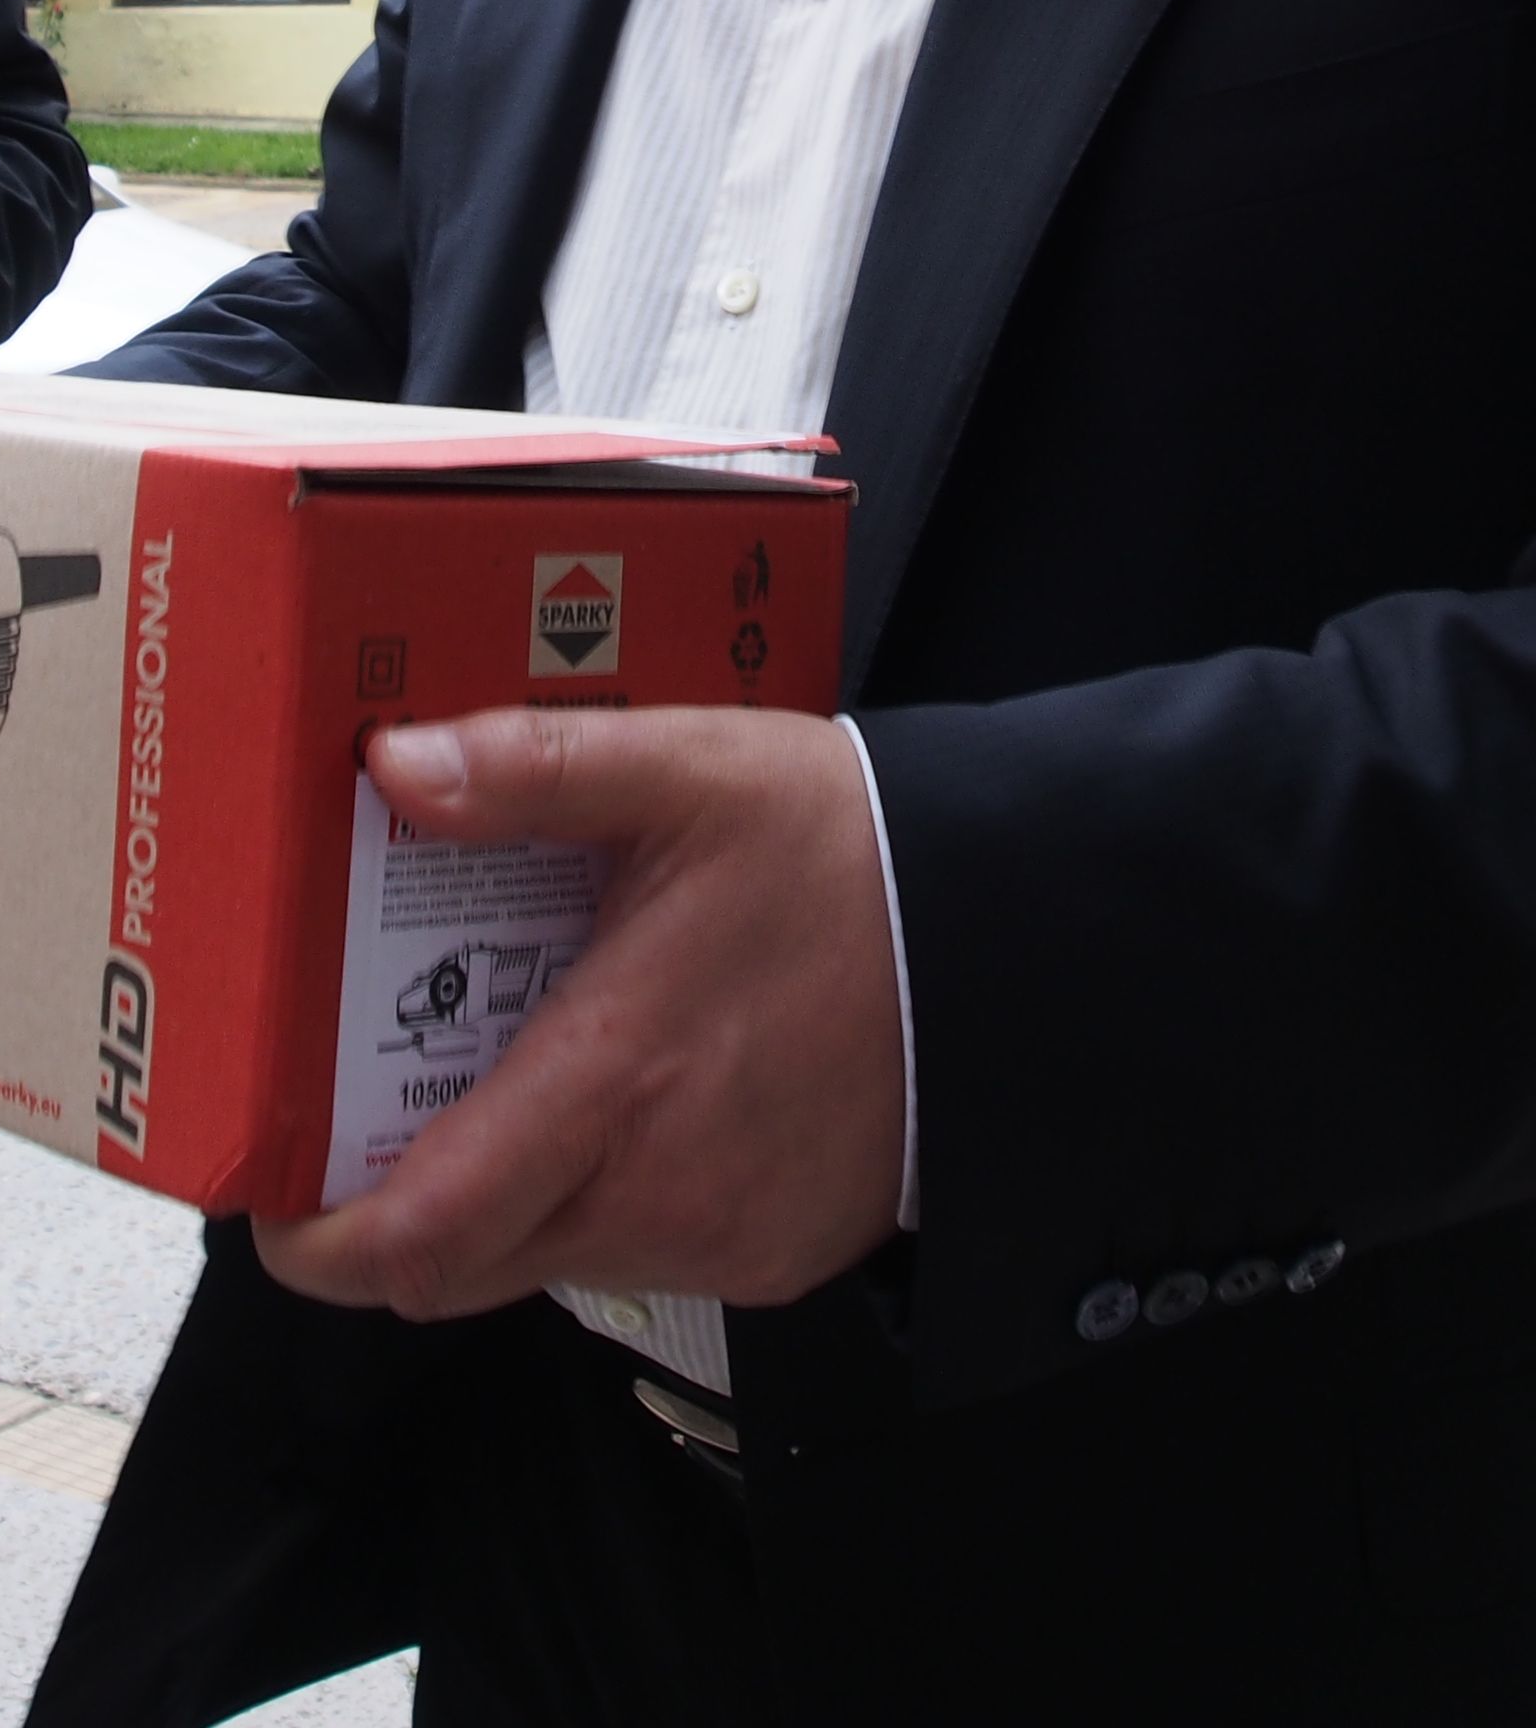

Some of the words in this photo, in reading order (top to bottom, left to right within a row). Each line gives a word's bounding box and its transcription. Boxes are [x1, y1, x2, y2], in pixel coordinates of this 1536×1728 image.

[538, 603, 614, 629] SPARKY
[121, 528, 174, 946] PROFESSIONAL
[95, 943, 154, 1160] HD
[399, 1072, 475, 1112] 1050W
